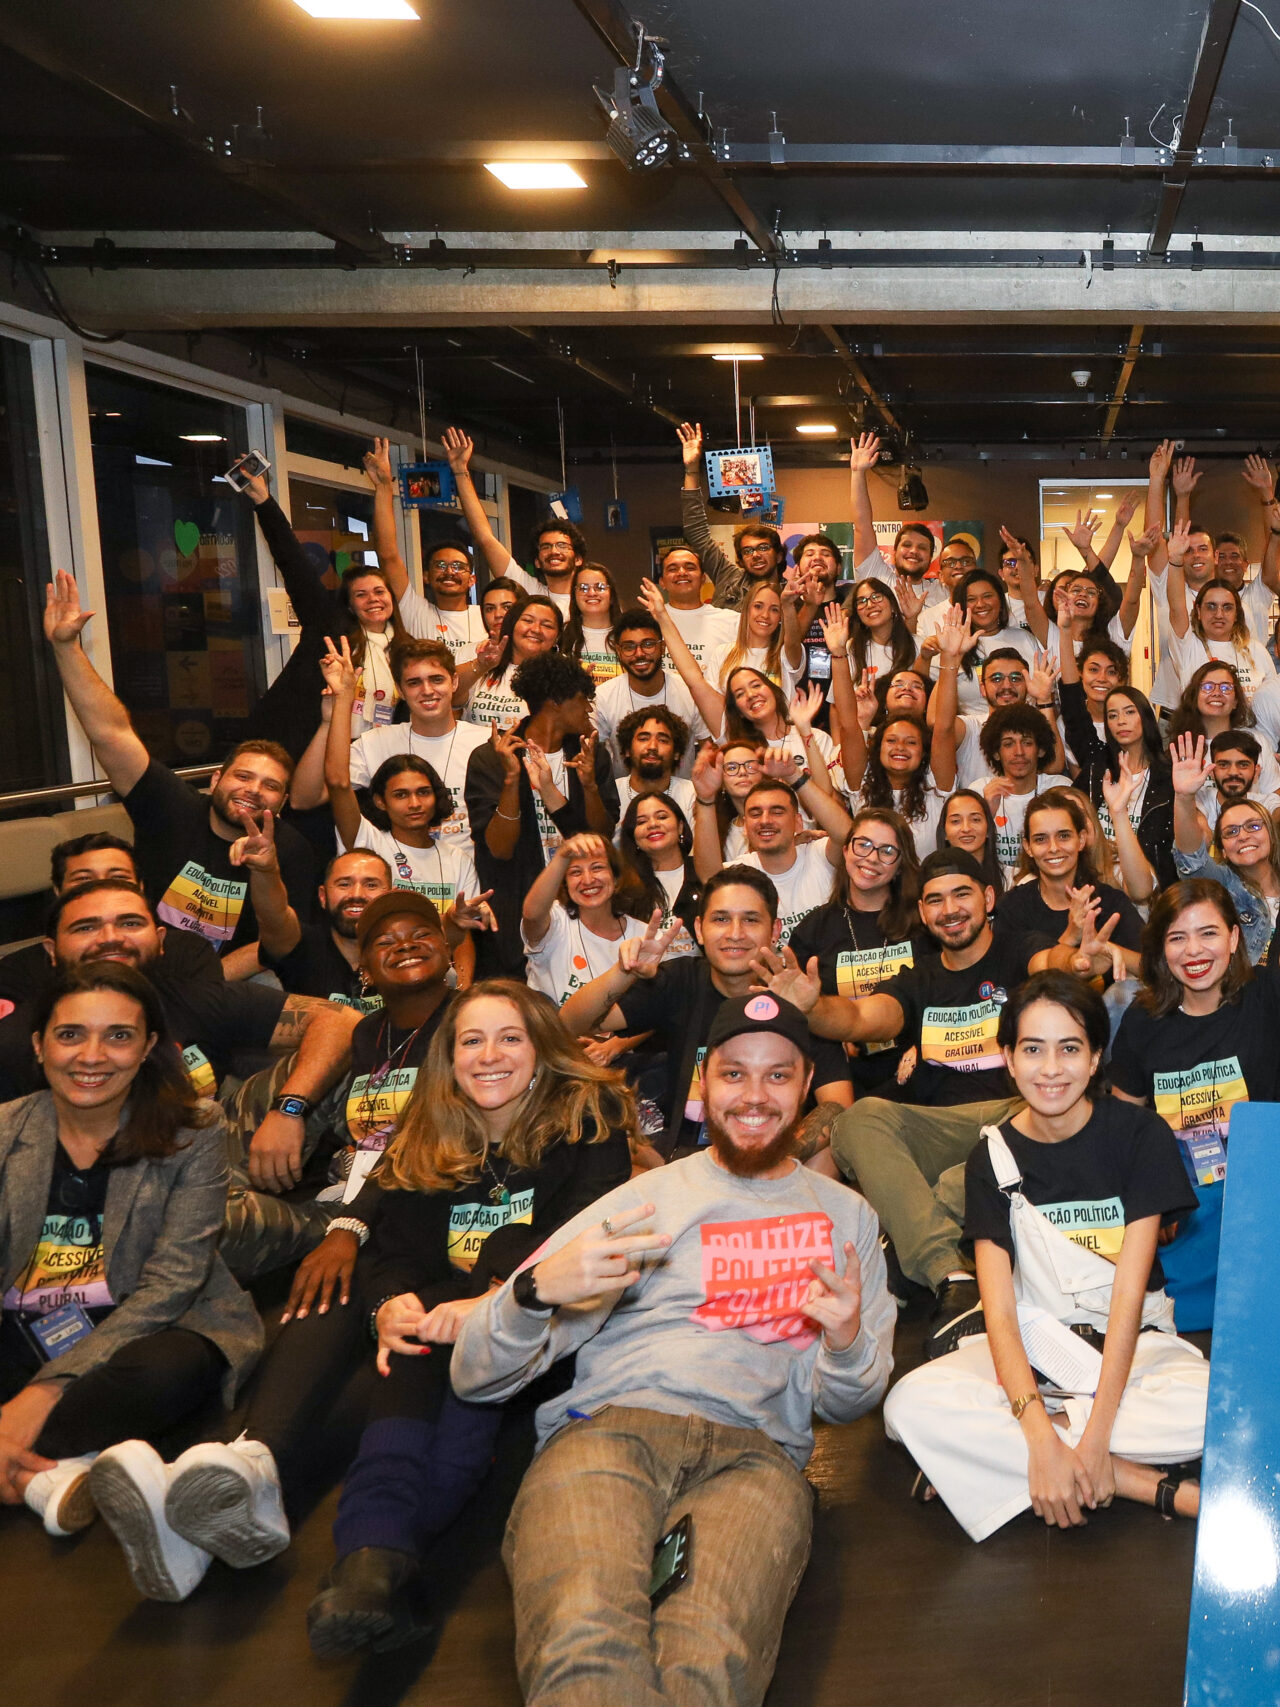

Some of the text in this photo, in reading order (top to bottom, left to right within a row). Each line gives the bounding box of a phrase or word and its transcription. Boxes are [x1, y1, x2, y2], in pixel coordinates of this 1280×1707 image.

[471, 701, 521, 713] política
[841, 951, 877, 963] EDUCAÇÃO
[857, 964, 894, 977] ACESSÍVEL
[928, 1010, 967, 1024] EDUCAÇÃO
[944, 1026, 984, 1042] ACESSÍVEL
[945, 1044, 984, 1058] GRATUITA
[1157, 1063, 1237, 1090] EDUCAÇÃO POLÍTICA
[1180, 1089, 1222, 1106] ACESSÍVEL
[1184, 1107, 1225, 1127] GRATUITA
[451, 1210, 499, 1227] DUCAÇÃO
[1042, 1205, 1119, 1225] AÇÃO POLÍTICA
